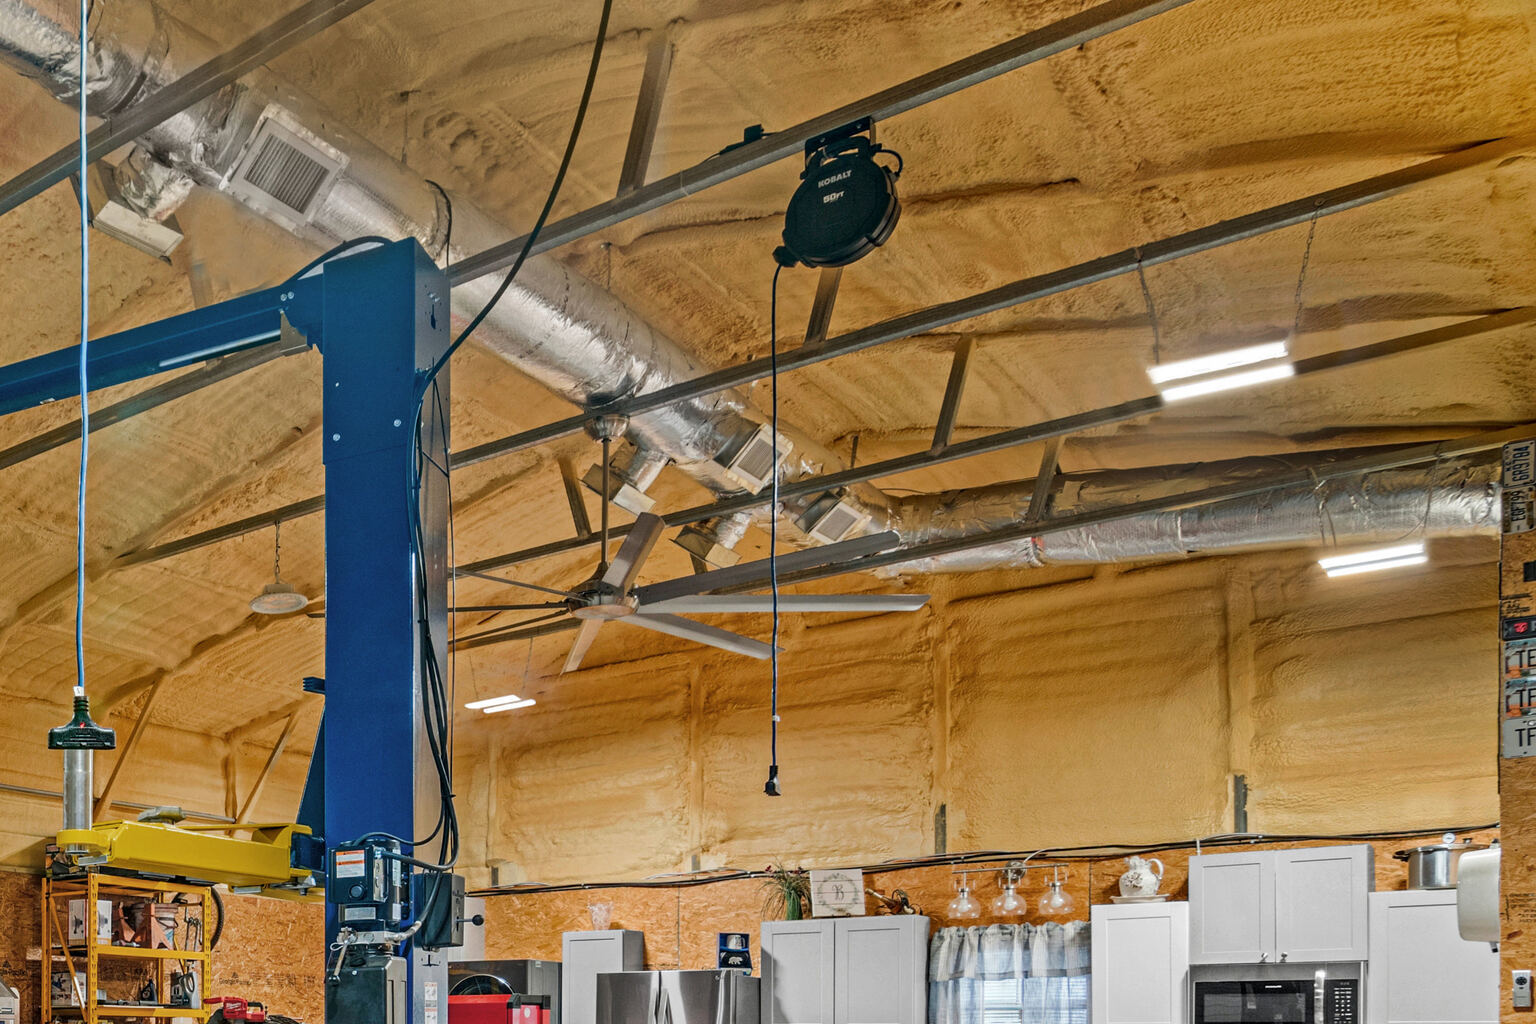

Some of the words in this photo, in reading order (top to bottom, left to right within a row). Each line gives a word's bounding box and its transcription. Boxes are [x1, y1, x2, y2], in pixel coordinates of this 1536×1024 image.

[817, 170, 852, 189] KOBALT
[1515, 649, 1536, 668] TE
[1515, 688, 1536, 708] TF
[1514, 727, 1536, 748] TF
